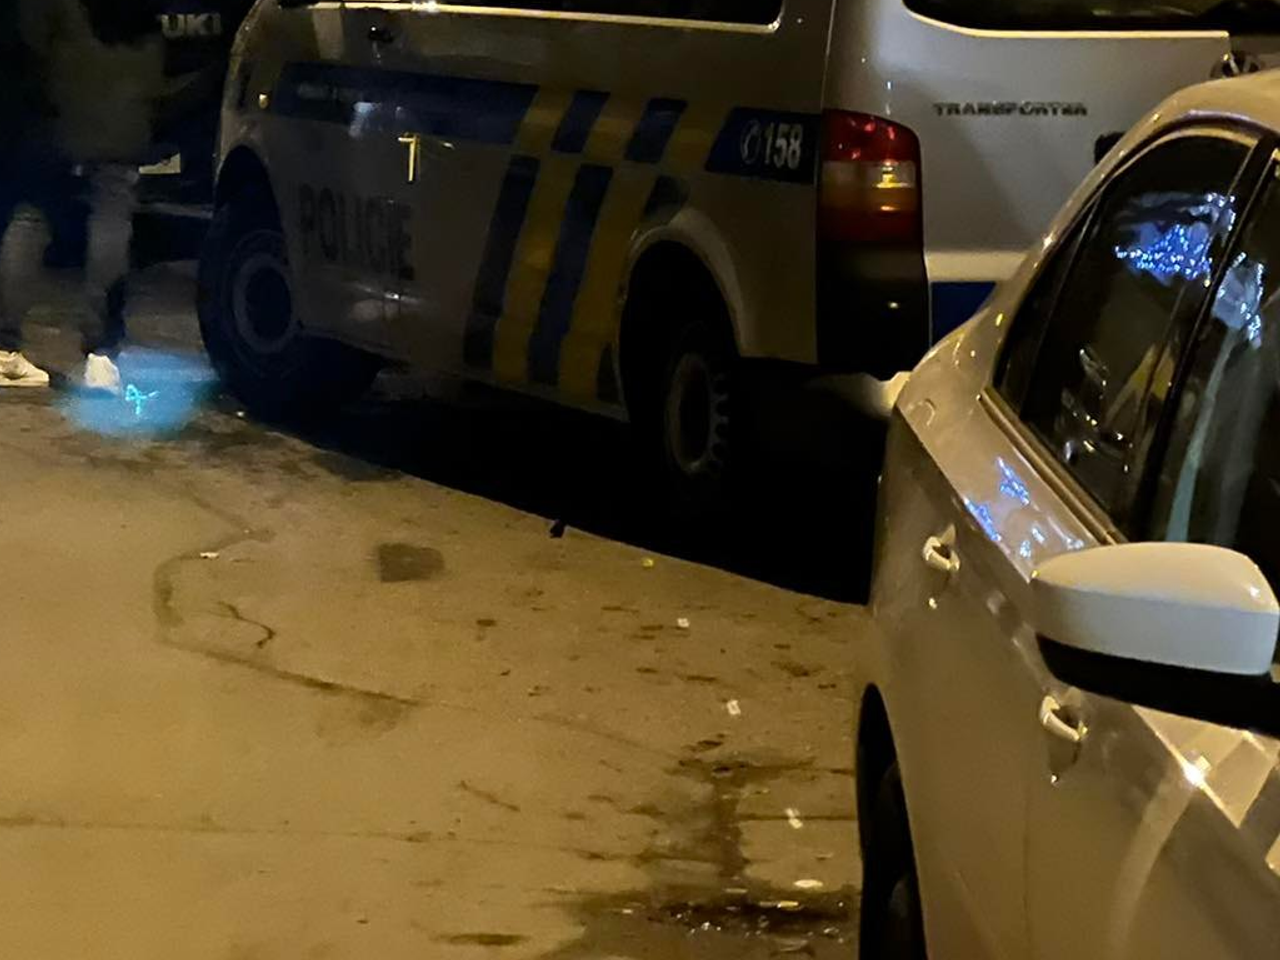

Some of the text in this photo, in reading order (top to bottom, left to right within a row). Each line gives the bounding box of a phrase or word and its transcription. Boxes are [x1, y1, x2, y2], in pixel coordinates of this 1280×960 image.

[159, 13, 222, 39] UKI
[933, 101, 1088, 117] TRANSPORTER
[763, 122, 804, 170] 158
